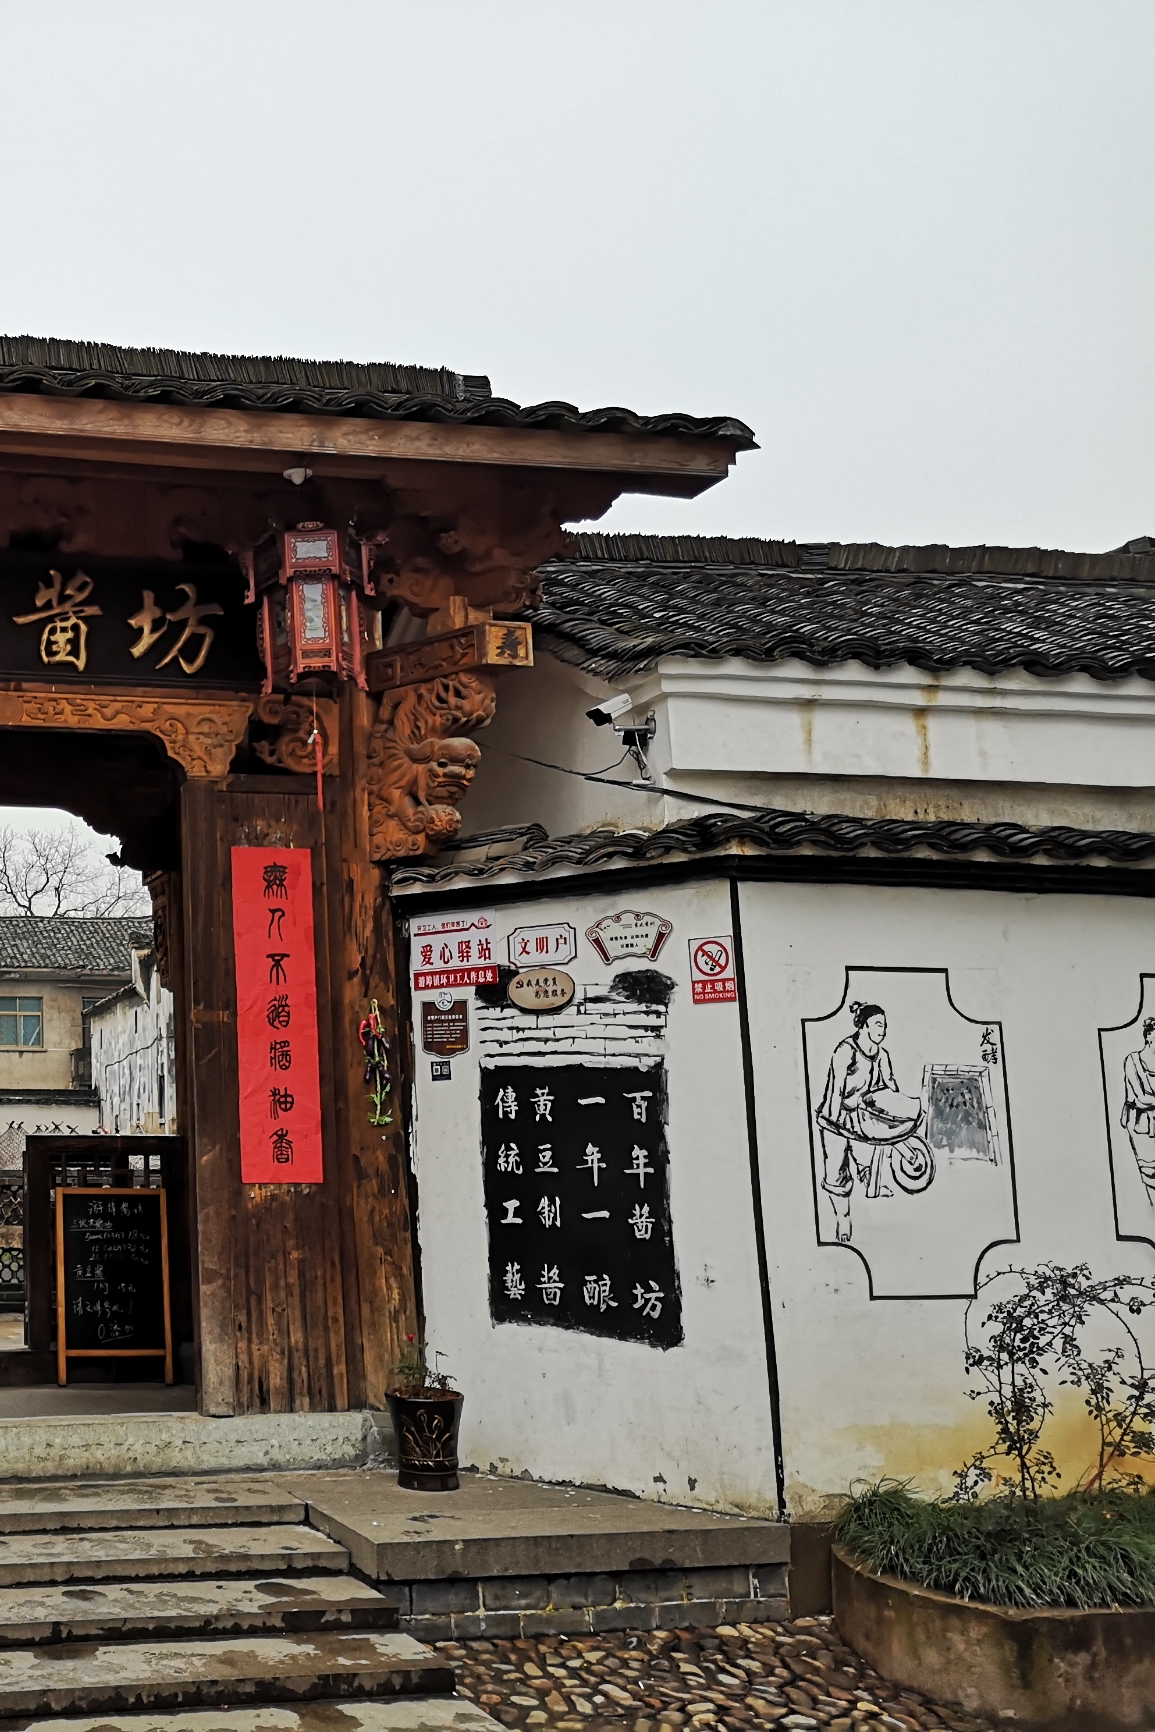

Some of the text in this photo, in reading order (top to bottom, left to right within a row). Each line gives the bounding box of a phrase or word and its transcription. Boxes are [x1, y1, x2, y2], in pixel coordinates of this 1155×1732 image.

[420, 937, 492, 967] 爱心驿站
[518, 934, 568, 957] 文明户
[694, 980, 735, 993] 禁止吸烟
[704, 991, 735, 999] SMOKING
[979, 1027, 999, 1065] 发酵
[575, 1096, 618, 1312] 一年一酿
